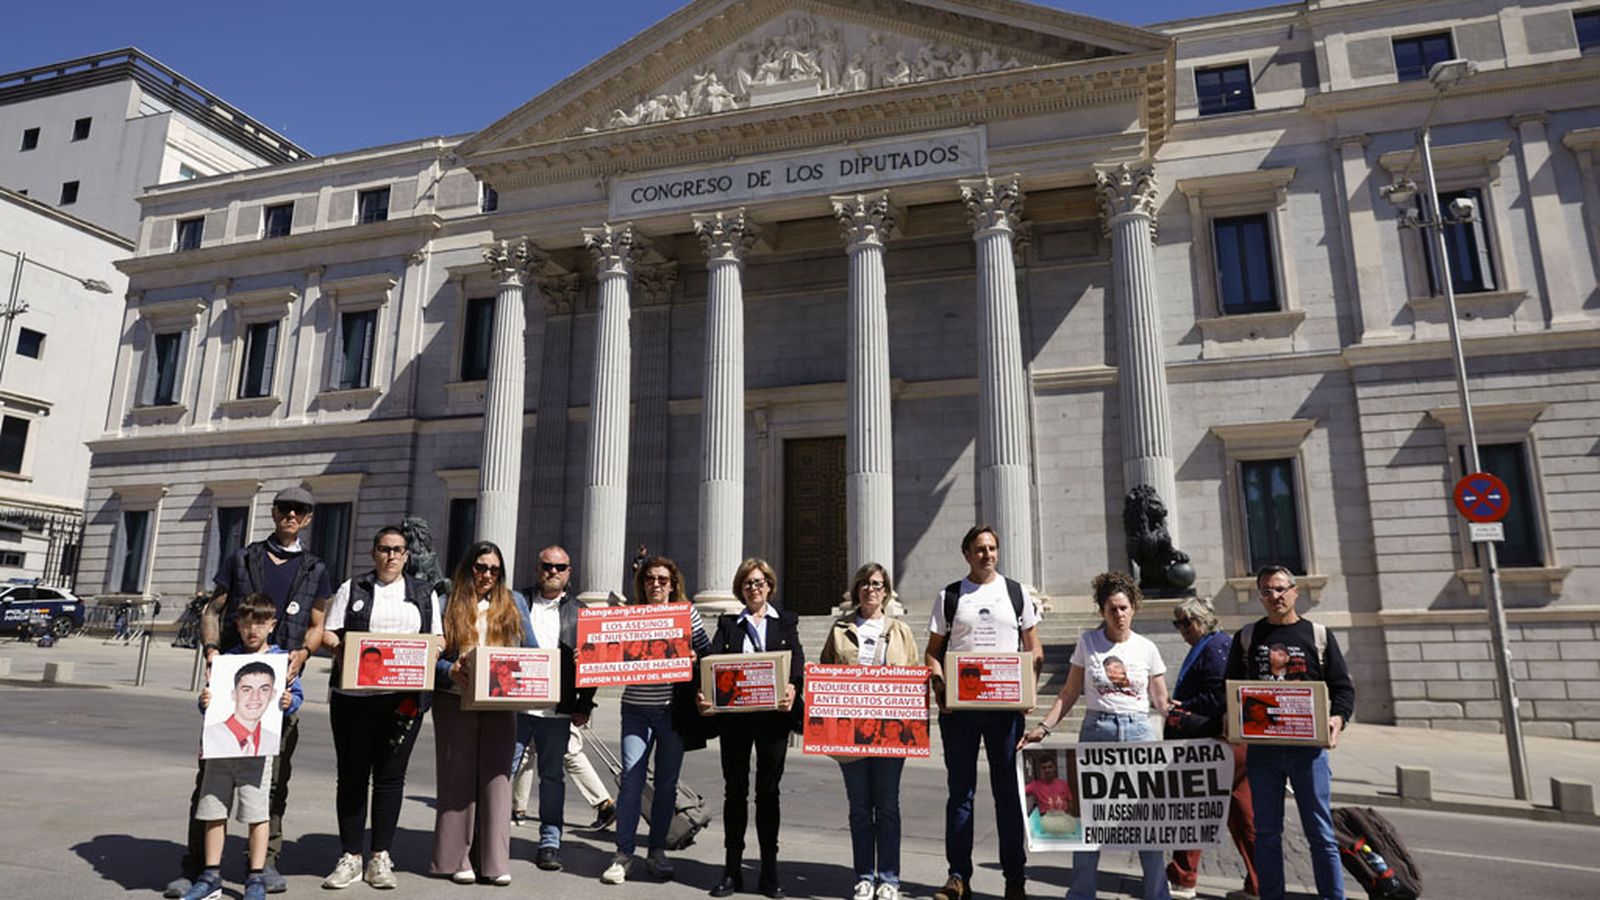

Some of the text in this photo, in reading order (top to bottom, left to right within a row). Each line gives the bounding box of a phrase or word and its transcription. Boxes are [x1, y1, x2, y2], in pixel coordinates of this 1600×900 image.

[631, 145, 959, 204] CONGRESO DE LOS DIPUTADOS
[606, 620, 669, 631] LOS ASESINOS
[590, 630, 681, 642] DE NUESTROS HIJOS
[618, 663, 630, 672] LO
[632, 662, 650, 671] QUE
[809, 666, 927, 677] change.org/LeyDelMenor
[632, 674, 645, 682] LEY
[646, 673, 659, 681] DEL
[812, 683, 926, 694] ENDURECER LAS PENAS
[815, 695, 922, 706] ANTE DELITOS GRAVES
[809, 707, 929, 719] COMETIDOS POR MENORES
[805, 745, 820, 753] NOS
[822, 746, 859, 755] QUITARON
[868, 747, 906, 755] NUESTROS
[908, 748, 929, 756] HIJOS
[1079, 744, 1226, 766] JUSTICIA PARA
[1080, 768, 1230, 800] DANIEL
[1092, 801, 1224, 821] UN ASESINO NO TIENE EDAD
[1085, 826, 1141, 844] ENDURECER
[1144, 826, 1157, 844] LA
[1159, 826, 1177, 844] LEY
[1179, 825, 1198, 844] DEL
